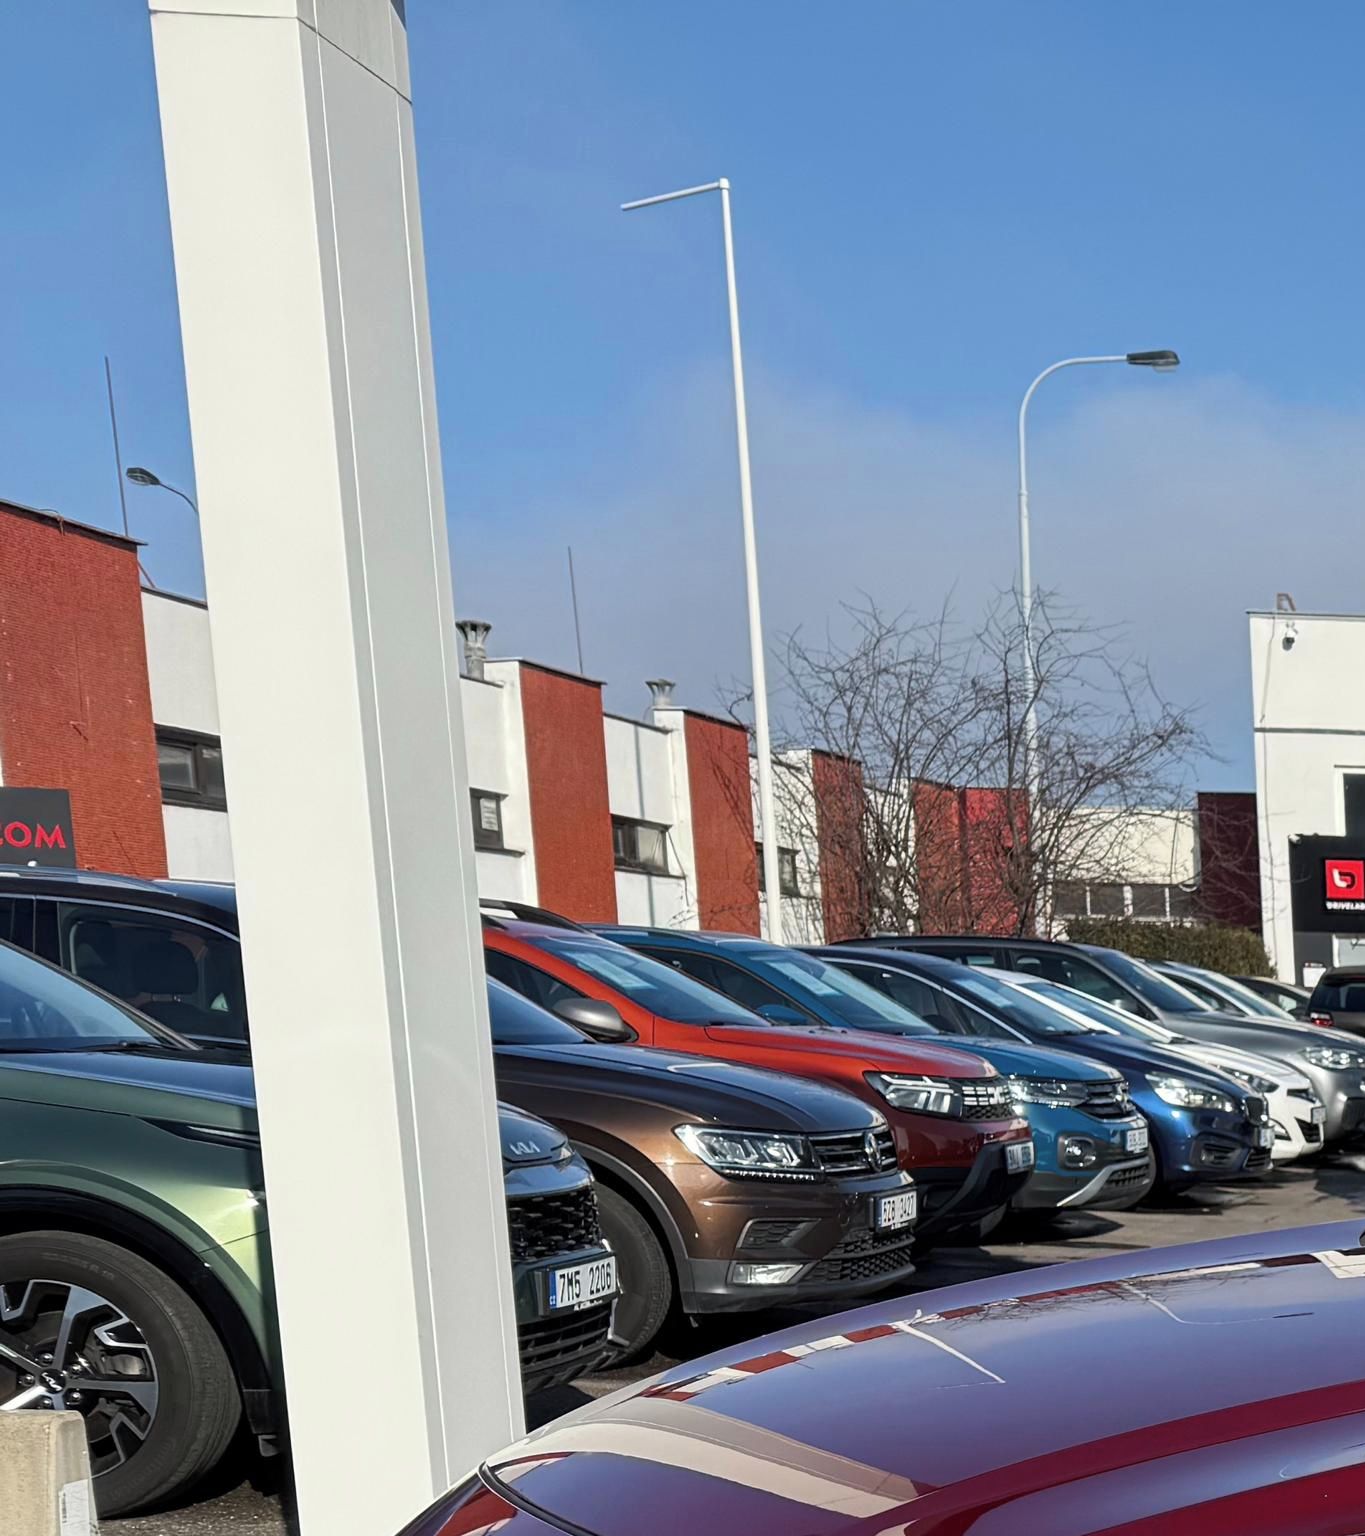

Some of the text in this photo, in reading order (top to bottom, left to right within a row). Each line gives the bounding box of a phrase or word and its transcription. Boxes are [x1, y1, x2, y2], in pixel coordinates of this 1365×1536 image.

[0, 820, 67, 849] OM
[559, 1262, 612, 1304] 7M5 2206
